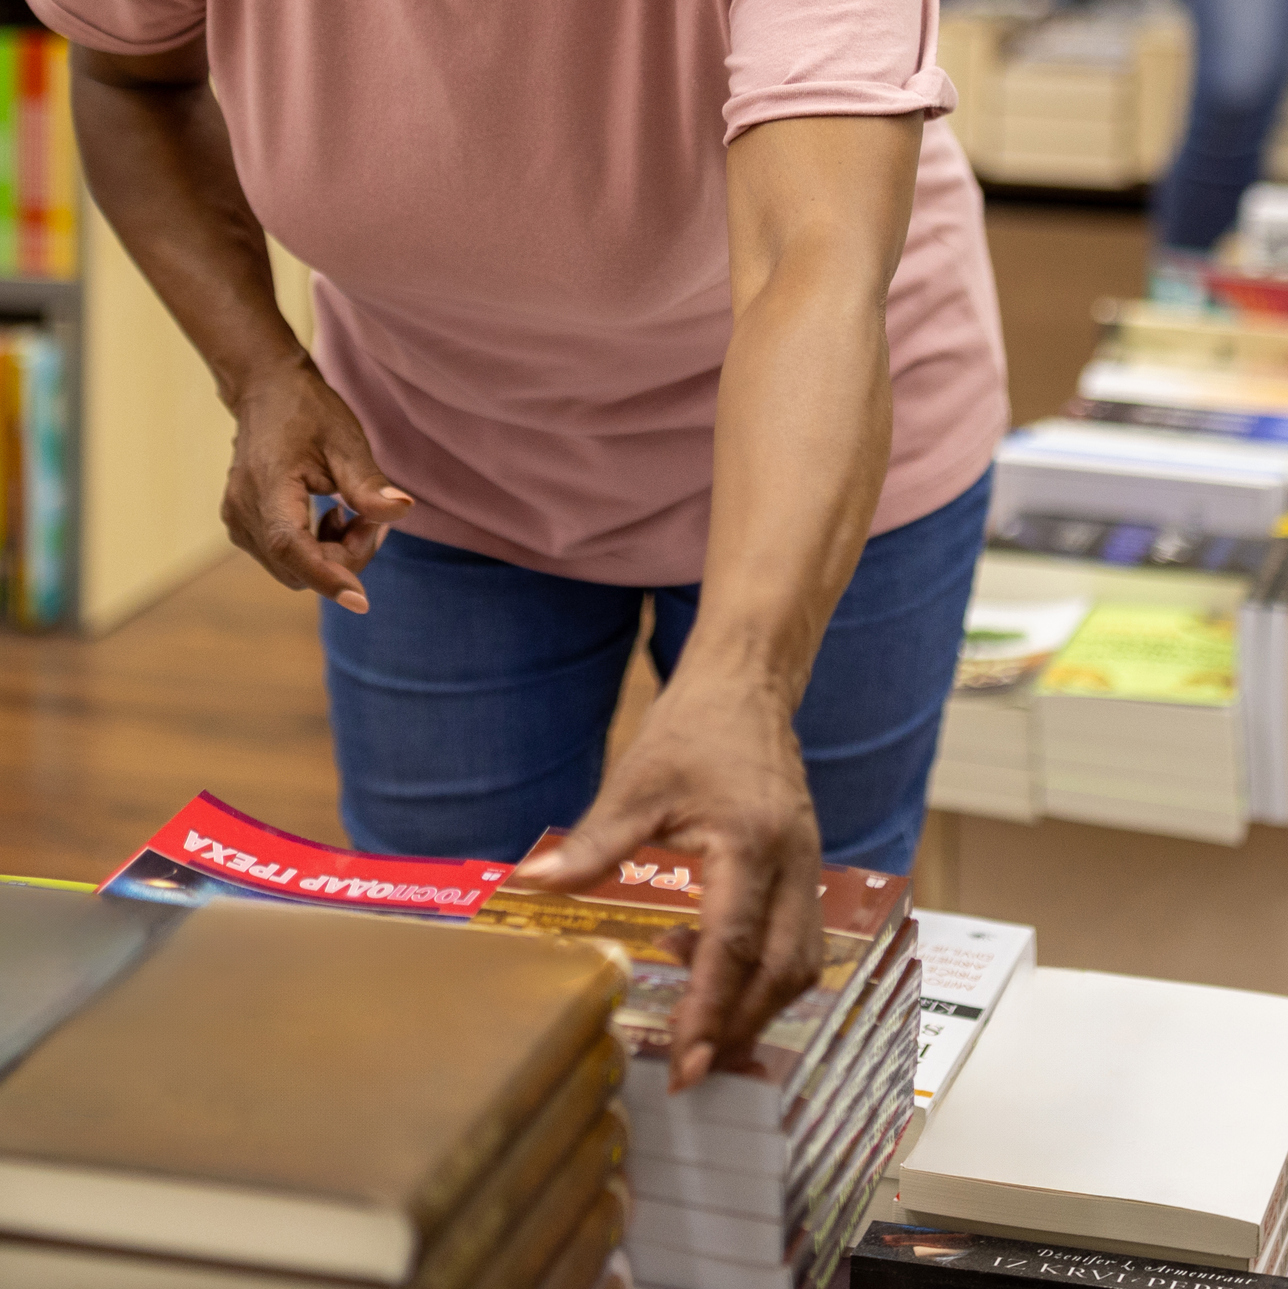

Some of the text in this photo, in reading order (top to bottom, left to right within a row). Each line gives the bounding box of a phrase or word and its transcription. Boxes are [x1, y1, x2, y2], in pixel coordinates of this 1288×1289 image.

[182, 829, 481, 907] ГОСПОДАР ГРЕХА
[992, 1255, 1028, 1272] IZ
[1039, 1262, 1127, 1284] KRVI
[1143, 1263, 1259, 1286] Armentraut
